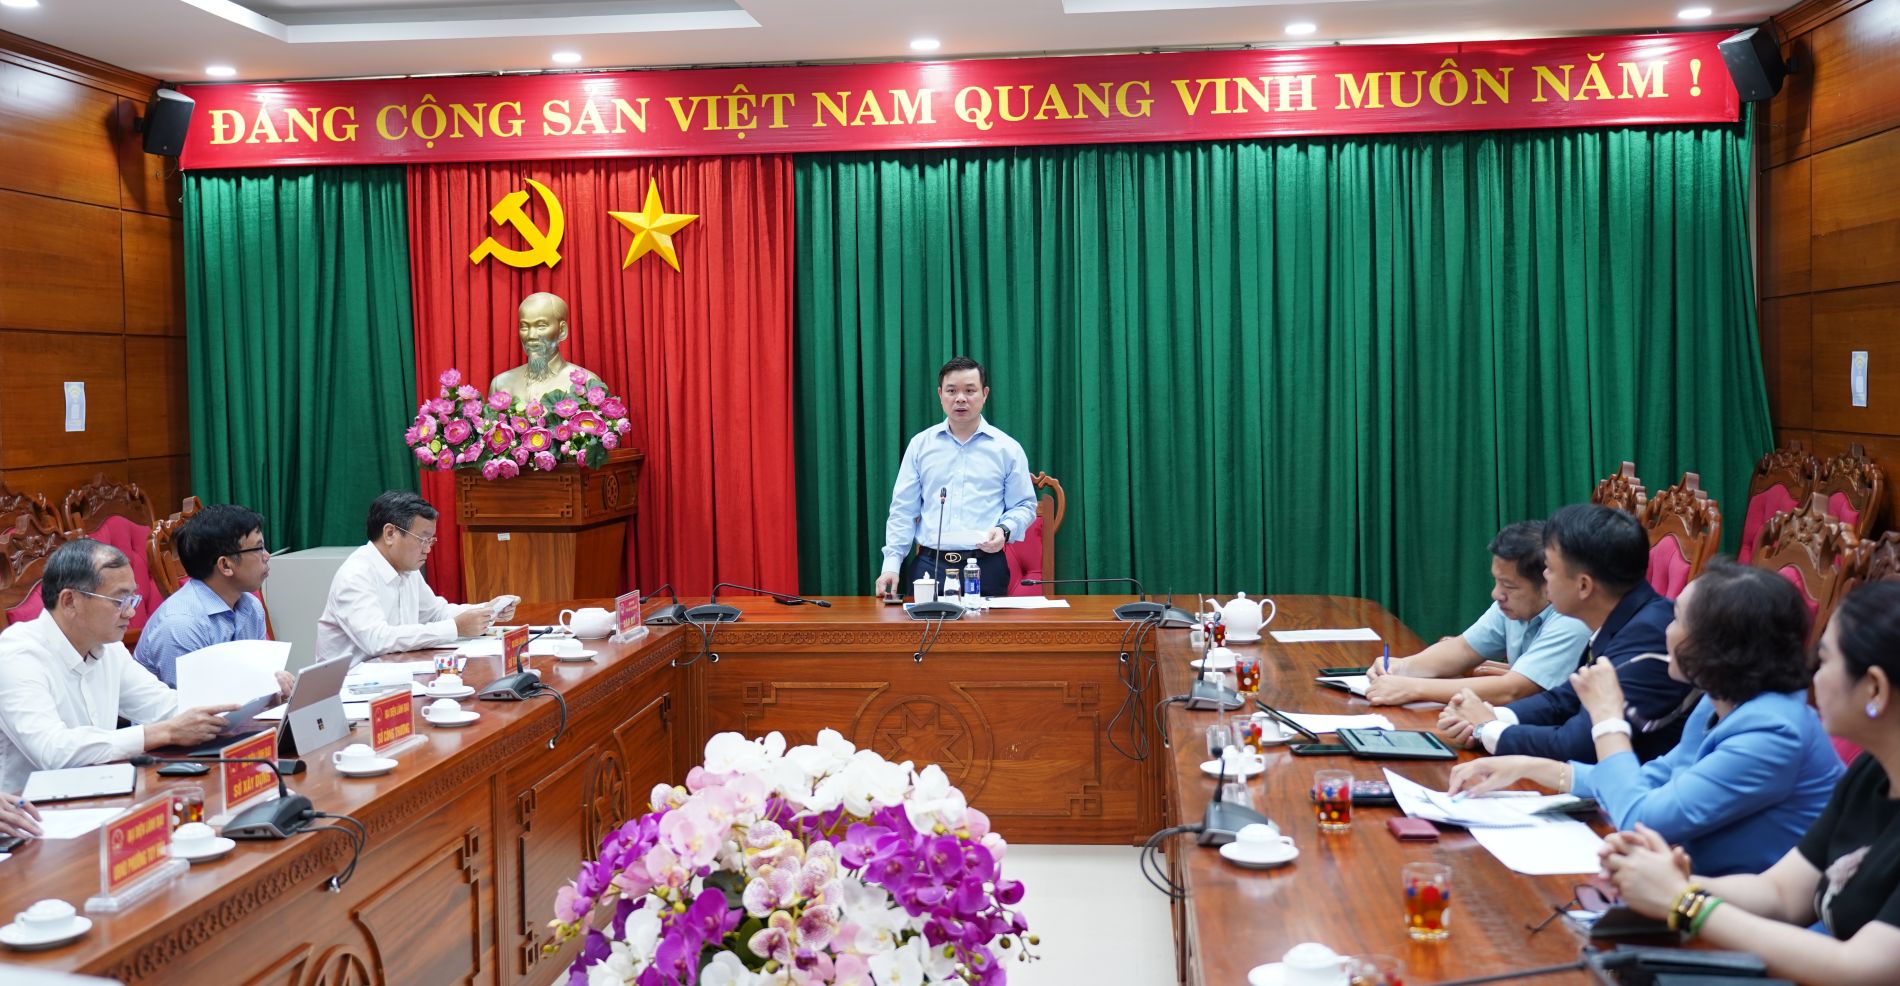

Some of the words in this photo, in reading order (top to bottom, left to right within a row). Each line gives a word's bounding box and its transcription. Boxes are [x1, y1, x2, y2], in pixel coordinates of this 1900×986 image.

[208, 95, 358, 145] ĐẢNG
[376, 93, 527, 148] CỘNG
[543, 86, 650, 136] SẢN
[666, 83, 795, 140] VIỆT
[812, 88, 937, 127] NAM
[954, 80, 1154, 131] QUANG
[1172, 74, 1318, 116] VINH
[1335, 57, 1515, 110] MUÔN
[1532, 53, 1669, 103] NĂM
[1690, 59, 1702, 97] !
[233, 779, 242, 798] SỞ
[243, 776, 254, 793] XÂY
